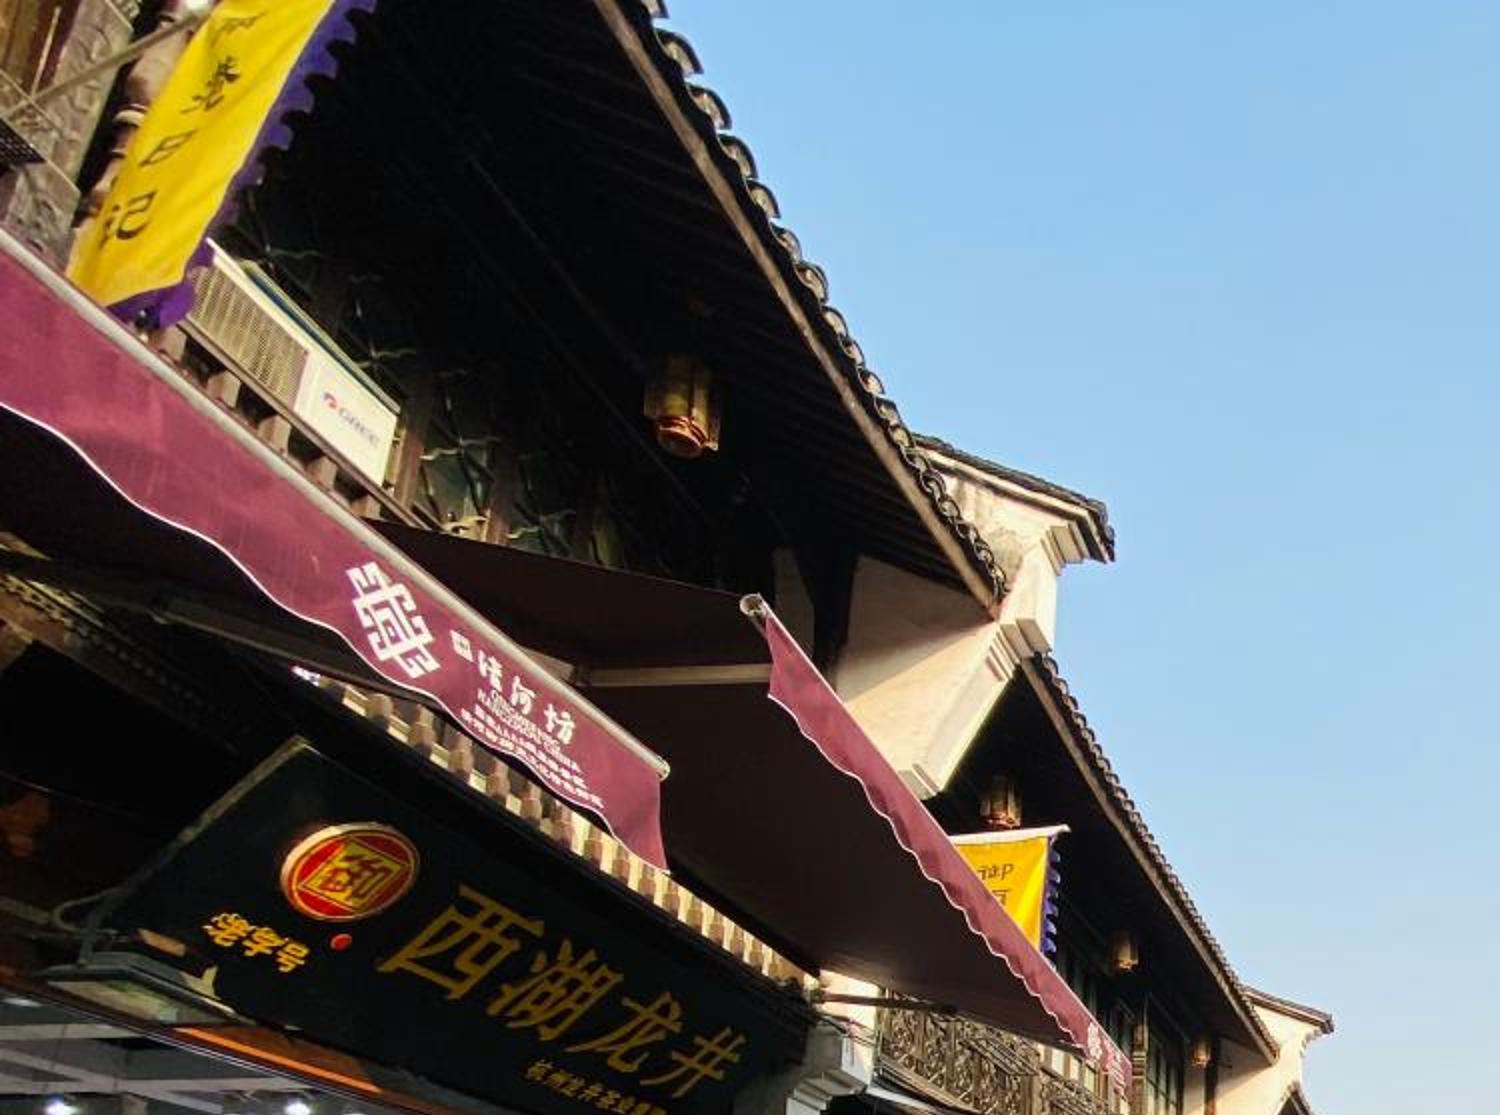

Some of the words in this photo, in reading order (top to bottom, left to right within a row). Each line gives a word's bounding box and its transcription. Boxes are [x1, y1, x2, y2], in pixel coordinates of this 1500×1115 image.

[203, 912, 310, 973] 老字号
[375, 883, 746, 1099] 西湖龙井
